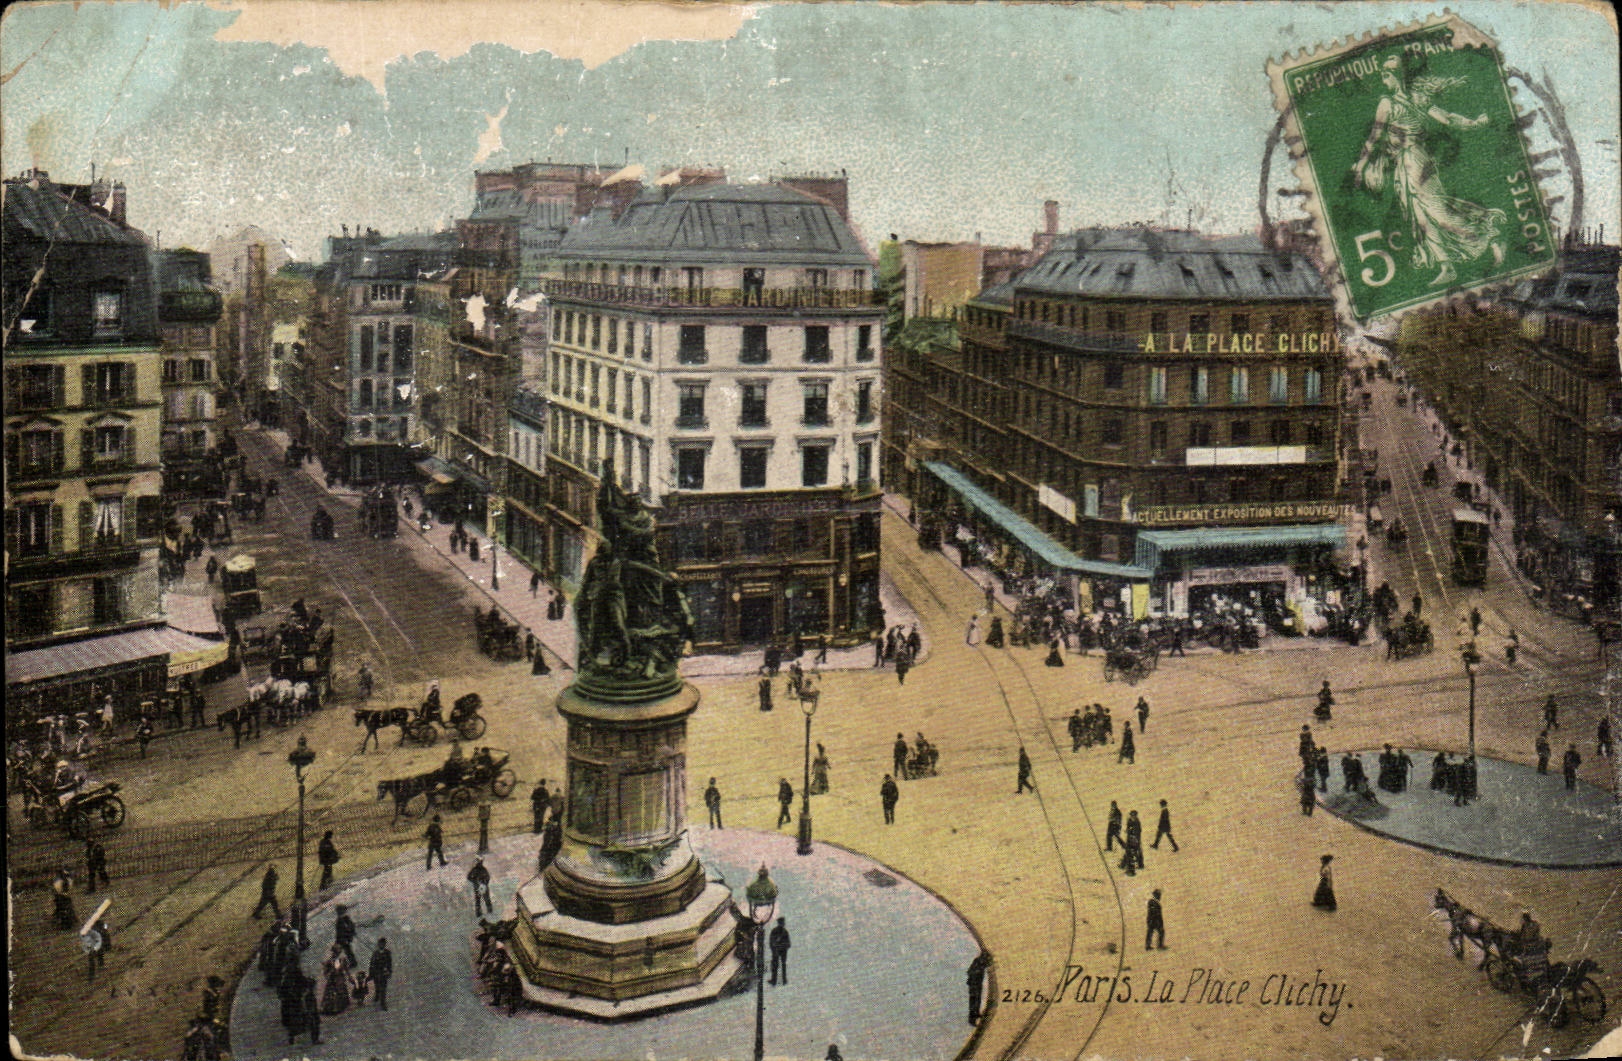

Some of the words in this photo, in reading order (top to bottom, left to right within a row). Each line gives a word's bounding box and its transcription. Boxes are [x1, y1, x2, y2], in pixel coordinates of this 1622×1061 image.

[1507, 169, 1547, 254] POSTES
[1169, 333, 1192, 353] LA
[1207, 333, 1265, 353] PLACE
[1278, 333, 1339, 353] CLICHY
[1132, 508, 1209, 523] ACTUELLEMENT
[1213, 505, 1272, 520] EXPOSITION
[1273, 504, 1294, 517] DES
